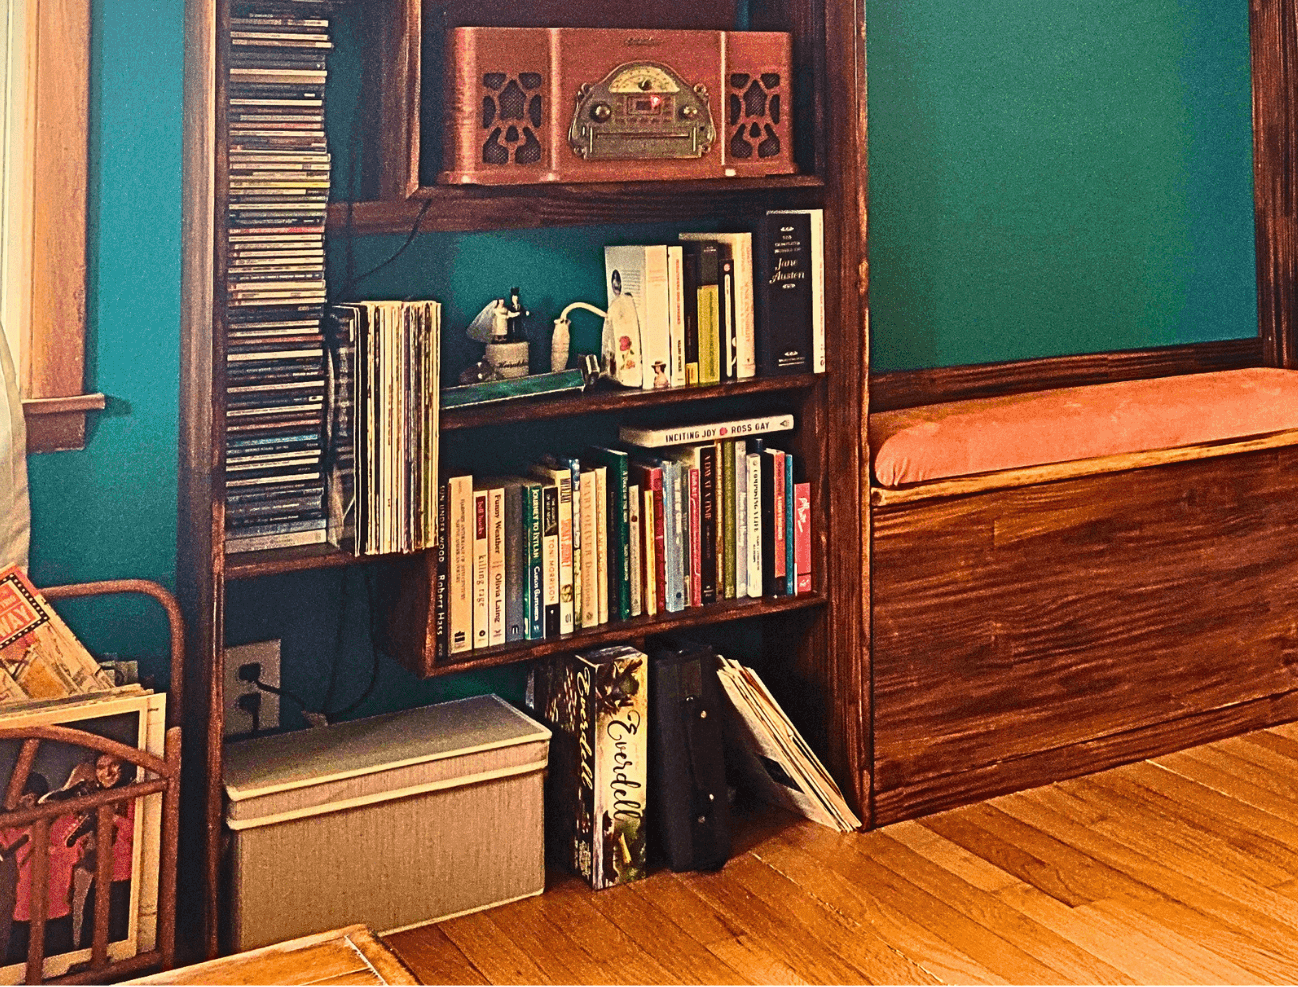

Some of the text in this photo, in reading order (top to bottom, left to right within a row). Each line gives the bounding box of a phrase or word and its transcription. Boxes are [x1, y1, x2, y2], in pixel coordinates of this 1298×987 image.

[768, 270, 805, 285] Austen
[774, 257, 799, 272] Jane
[665, 421, 771, 443] INCITING JOY ROSS GAY
[532, 489, 542, 521] JOURNEY
[585, 479, 593, 510] MARY
[438, 503, 446, 533] UNDER
[494, 494, 504, 554] Funny Weather
[585, 513, 593, 555] OLIVER
[438, 535, 446, 563] WOOD
[476, 554, 488, 607] killing rage
[494, 572, 504, 623] Olivia Laing
[549, 564, 557, 602] MORRISON
[437, 573, 447, 636] Robert Hass
[605, 709, 644, 823] Everdell
